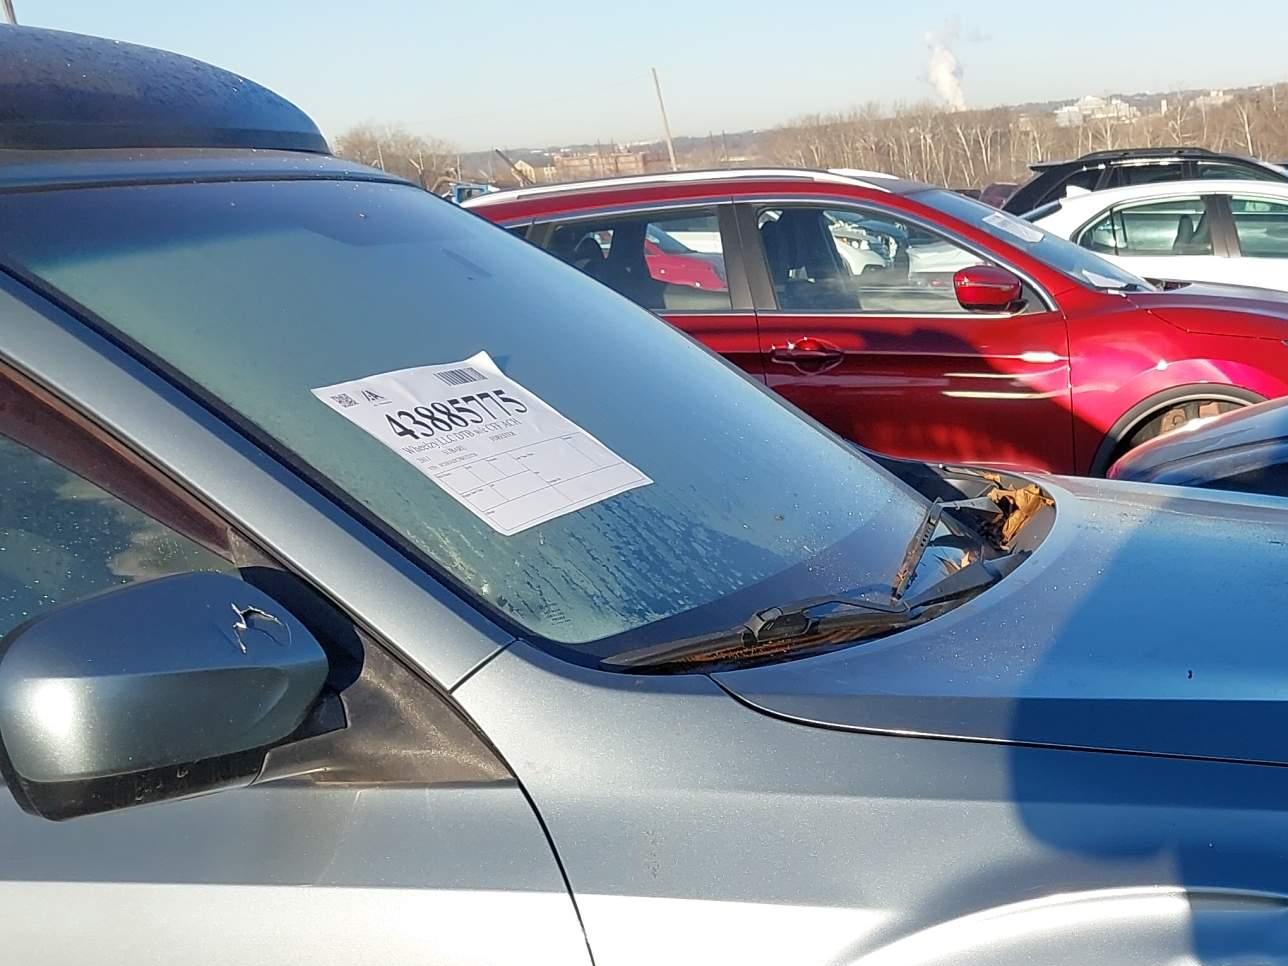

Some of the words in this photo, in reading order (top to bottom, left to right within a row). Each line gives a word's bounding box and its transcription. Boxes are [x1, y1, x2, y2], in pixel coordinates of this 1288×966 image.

[385, 389, 528, 440] 43885775
[434, 434, 456, 446] LLC
[452, 429, 475, 442] DTB
